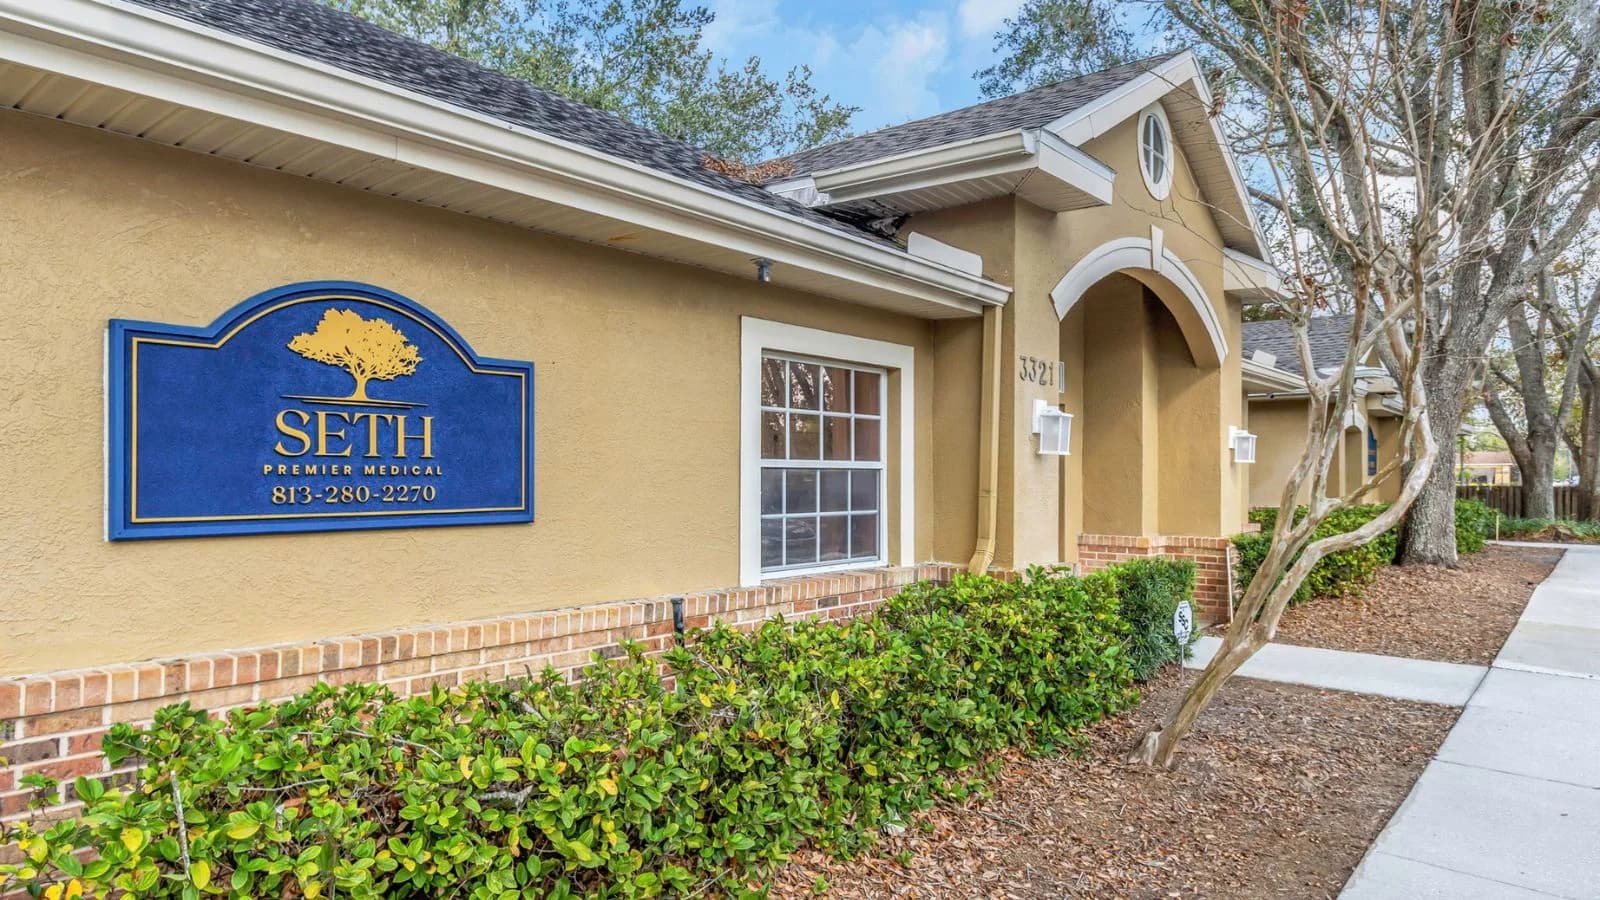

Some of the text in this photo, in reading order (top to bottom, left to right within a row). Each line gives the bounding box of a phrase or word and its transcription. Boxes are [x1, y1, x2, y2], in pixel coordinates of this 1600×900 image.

[1019, 354, 1054, 386] 3321
[274, 409, 435, 458] SETH
[263, 464, 442, 476] PREMIER MEDICAL
[272, 485, 437, 504] 813-280-2270
